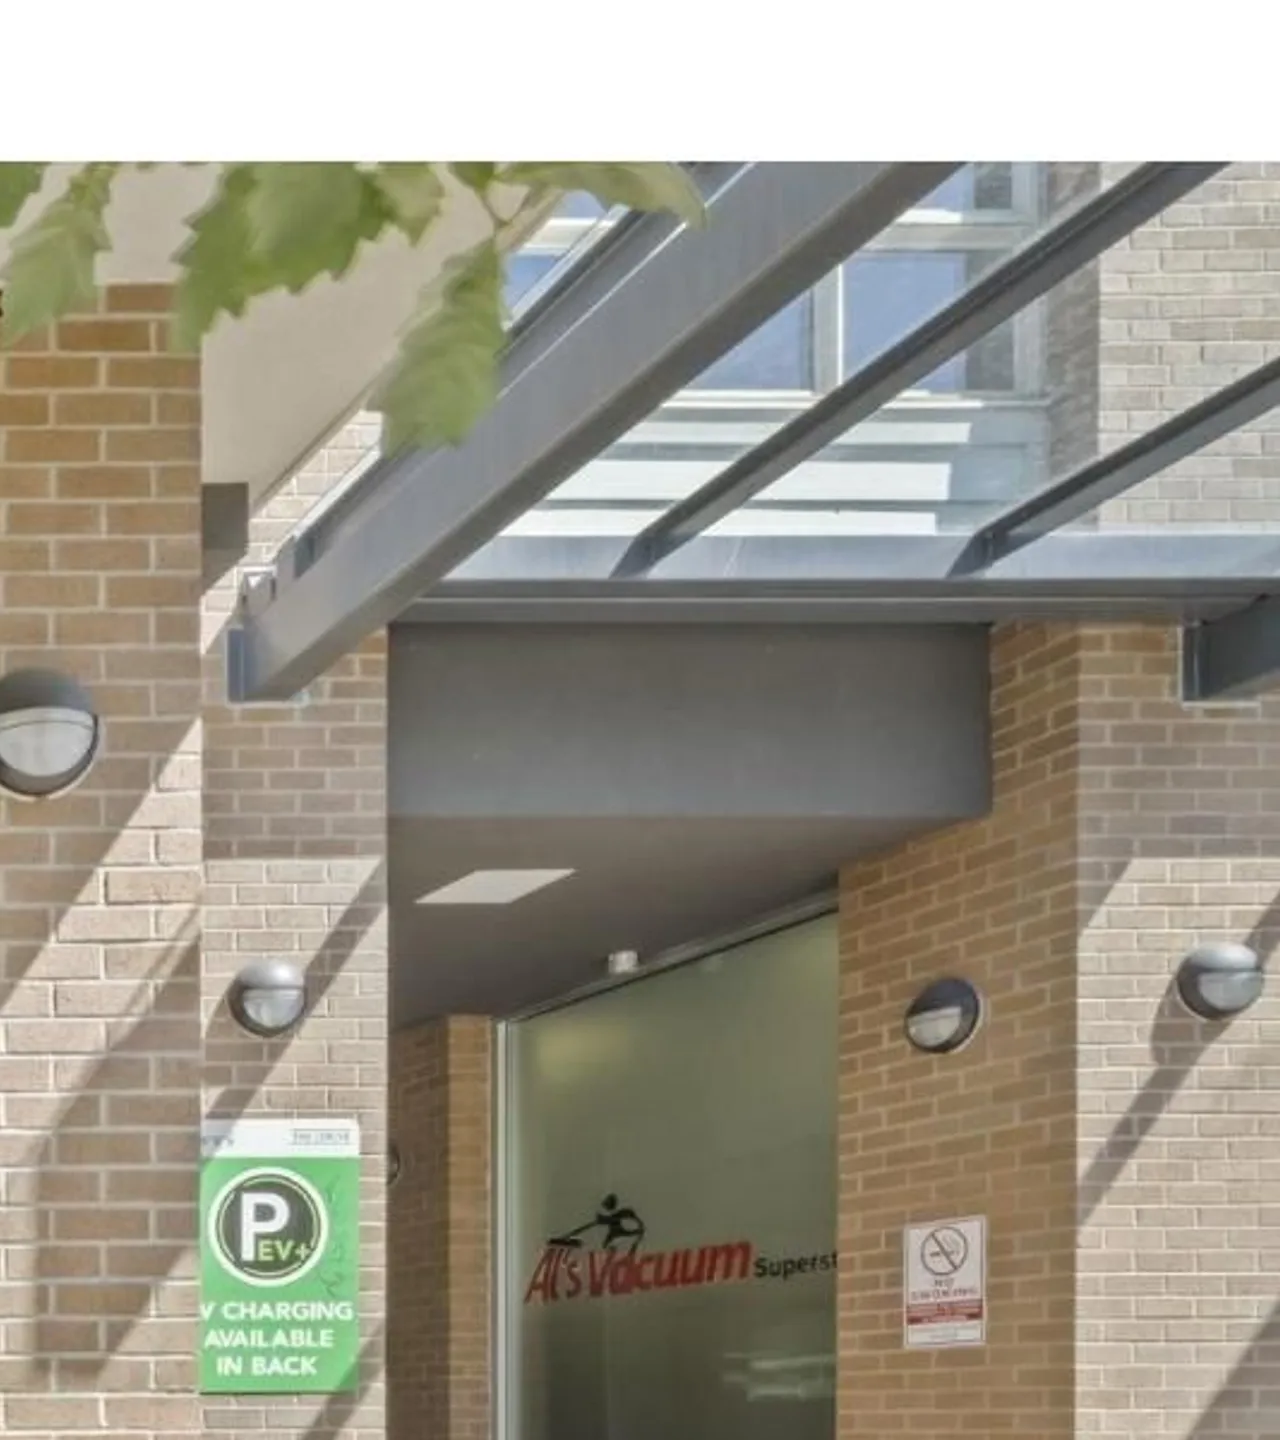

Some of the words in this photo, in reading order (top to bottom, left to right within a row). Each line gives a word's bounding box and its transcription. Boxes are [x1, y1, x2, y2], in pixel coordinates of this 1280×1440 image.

[240, 1192, 291, 1262] P
[524, 1246, 582, 1304] Al's
[588, 1240, 752, 1297] Vacuum
[753, 1252, 838, 1279] Superst
[199, 1302, 216, 1321] V
[221, 1301, 354, 1321] CHARGING
[204, 1329, 335, 1349] AVAILABLE
[216, 1357, 243, 1376] IN
[251, 1356, 318, 1376] BACK
